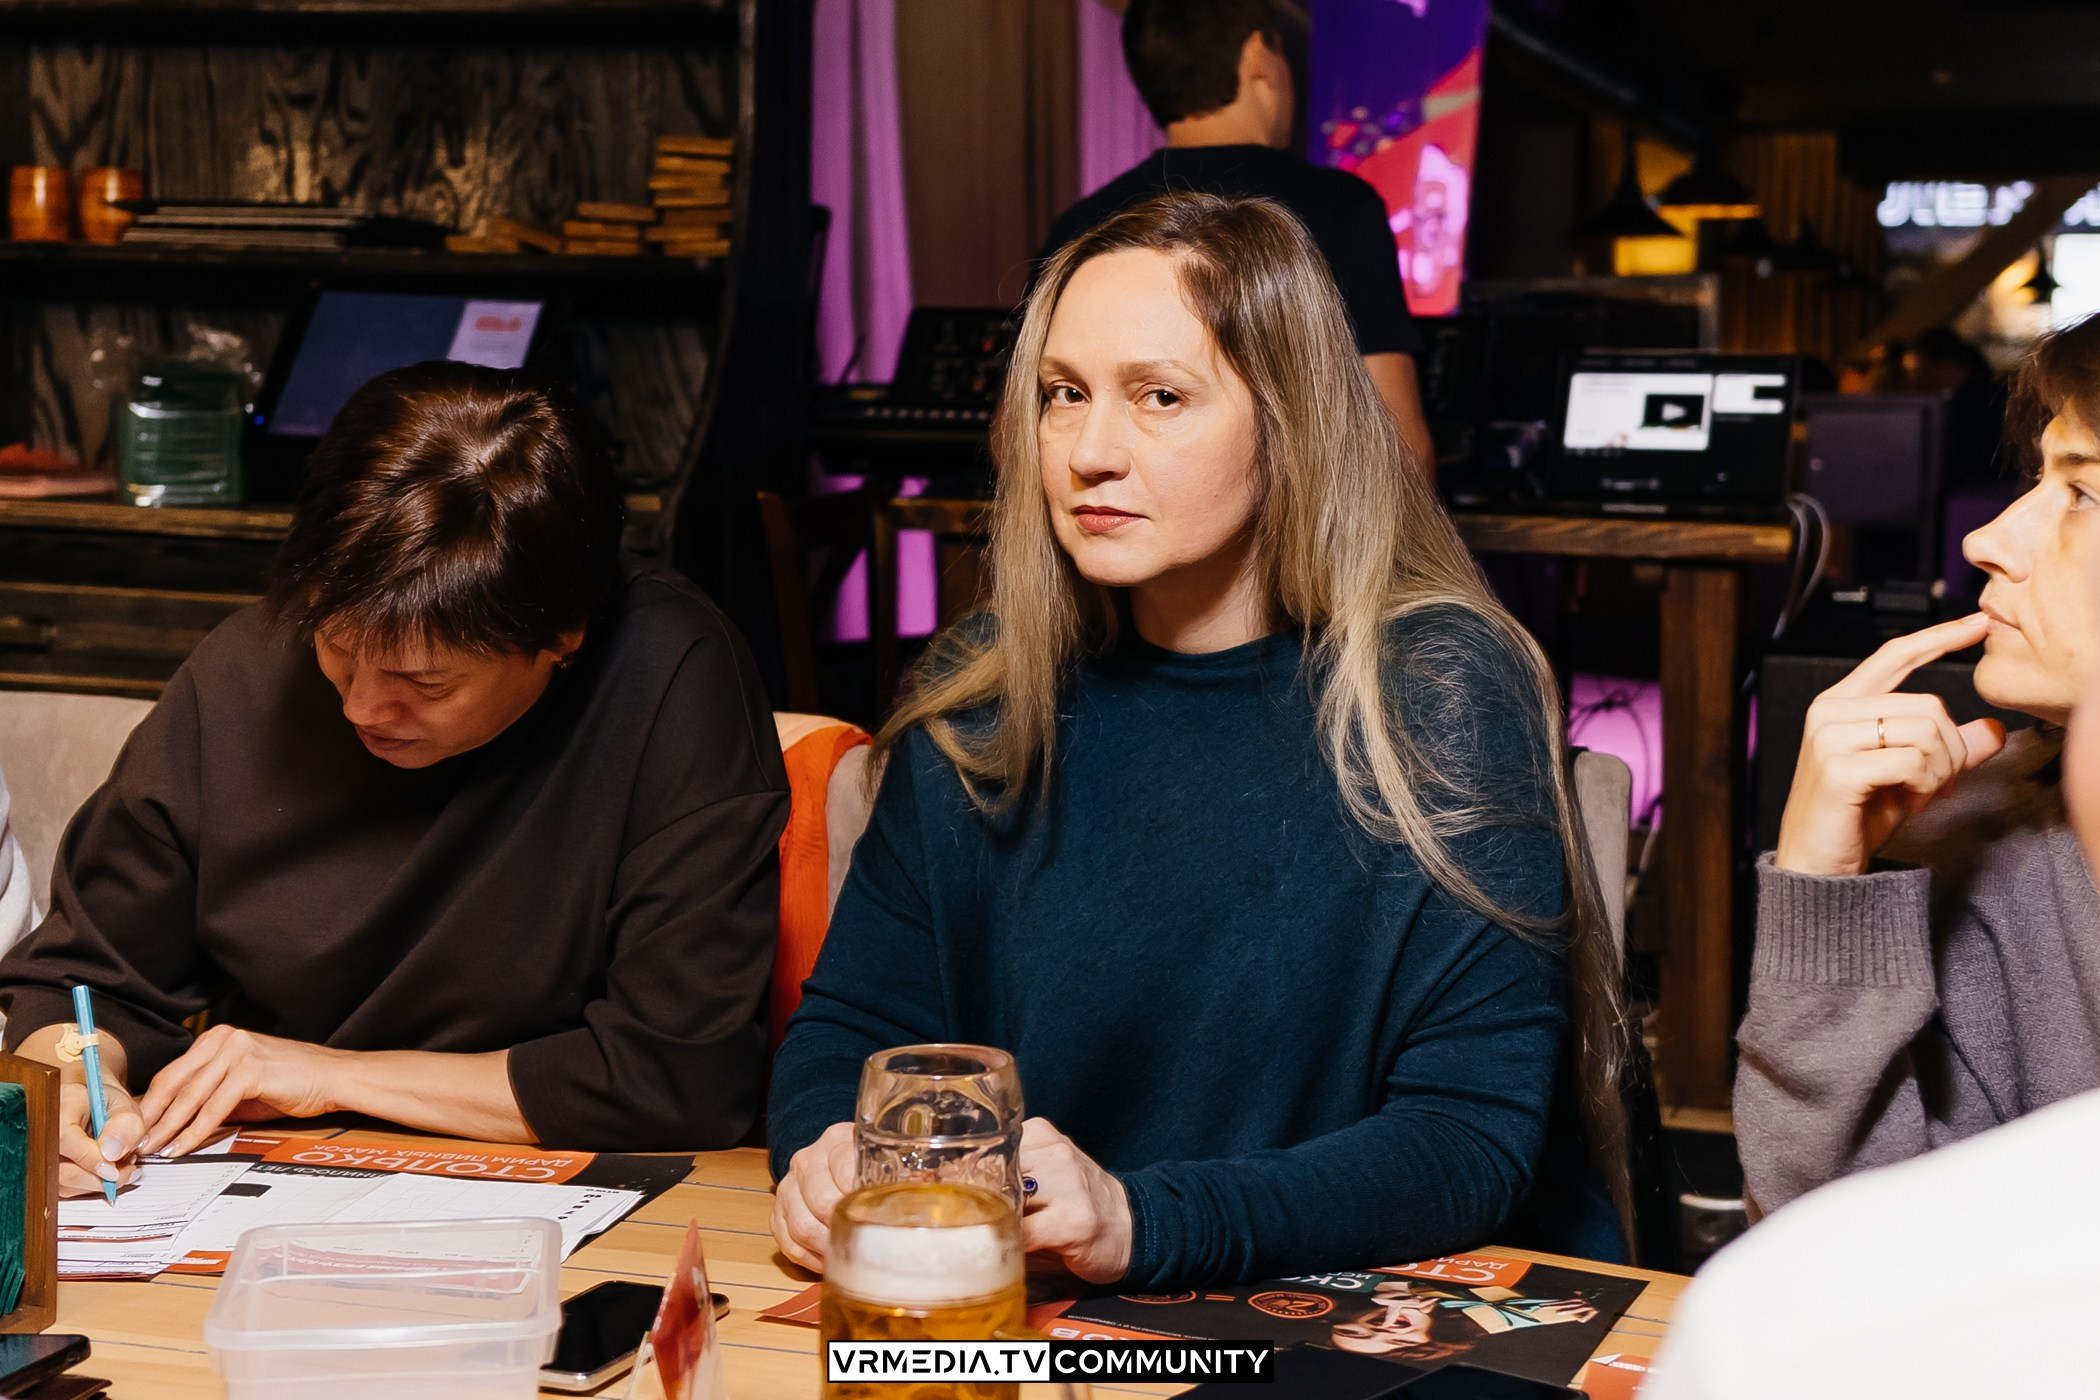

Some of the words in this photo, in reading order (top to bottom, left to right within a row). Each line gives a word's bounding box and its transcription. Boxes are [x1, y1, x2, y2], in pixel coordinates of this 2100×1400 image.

[310, 1144, 390, 1156] МАРОК
[394, 1148, 488, 1163] ПИВНЫХ
[292, 1151, 557, 1180] СТОЛЬКО
[492, 1155, 574, 1169] ДАРИМ
[1430, 1257, 1508, 1270] ДАРИ
